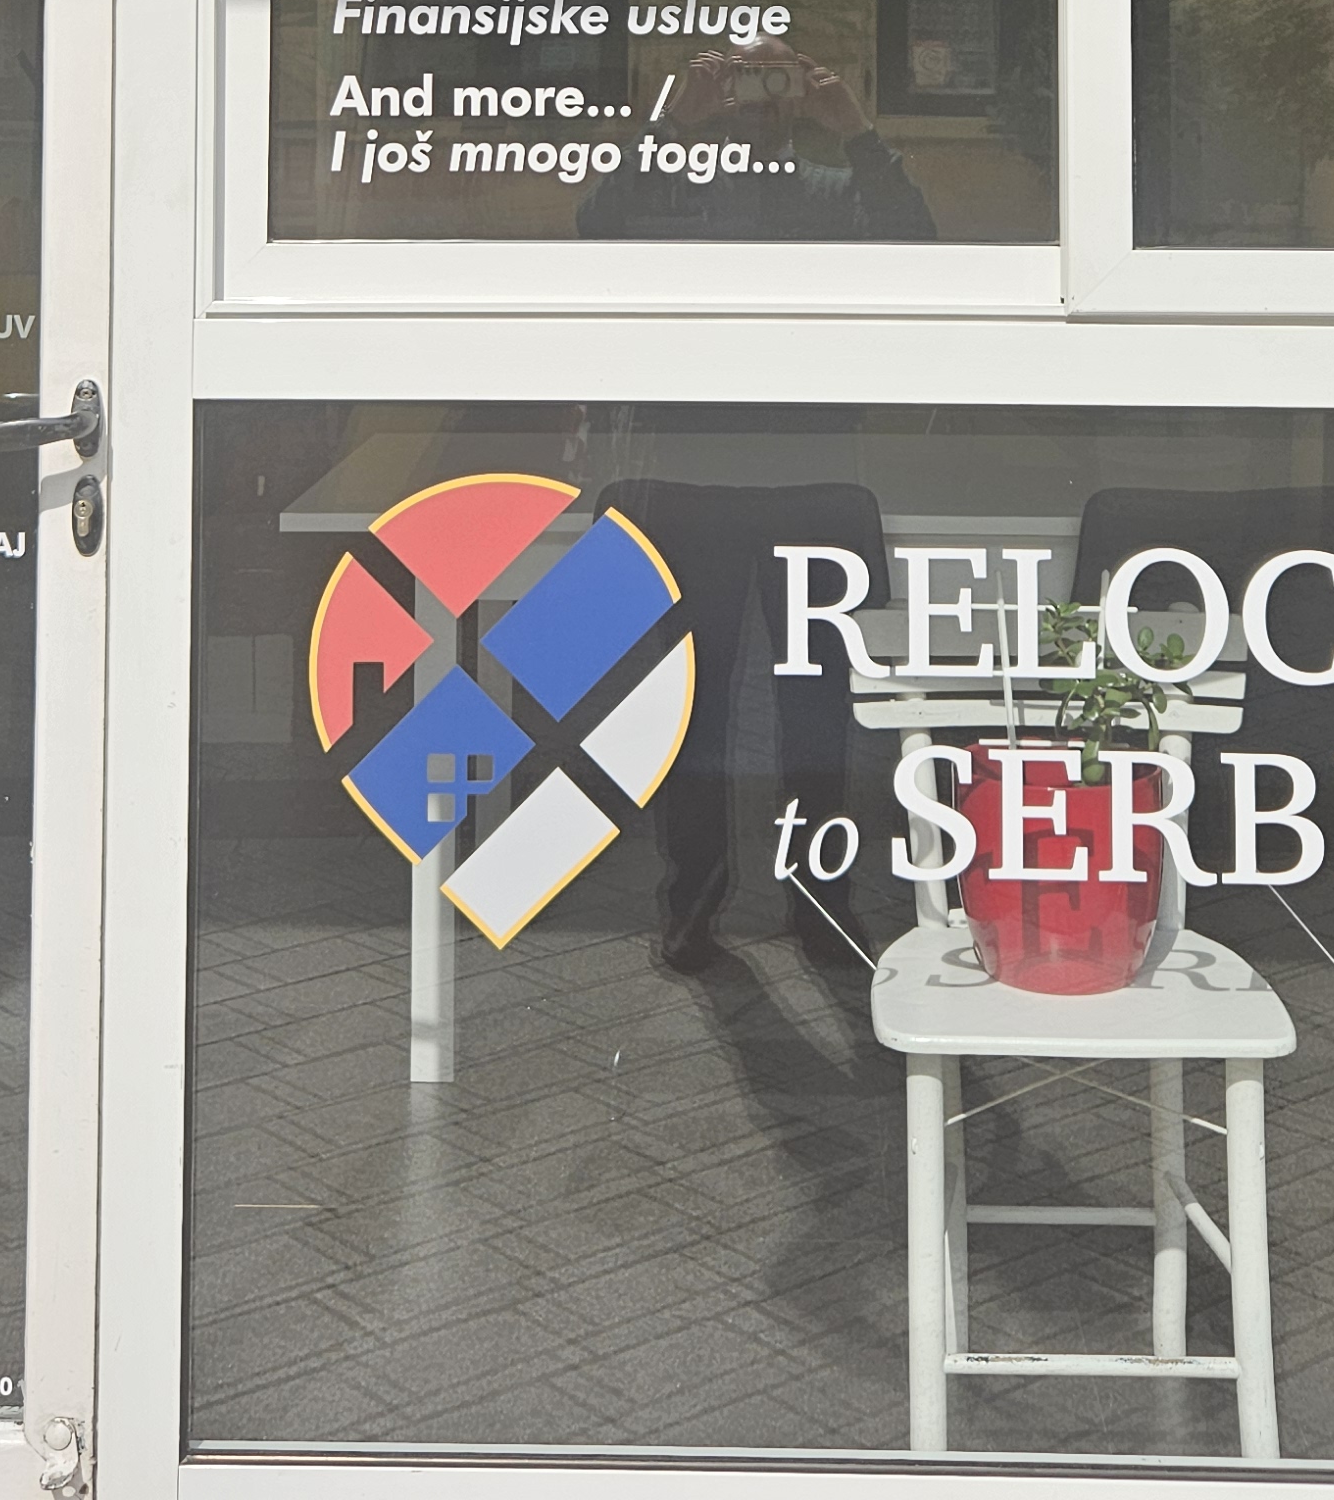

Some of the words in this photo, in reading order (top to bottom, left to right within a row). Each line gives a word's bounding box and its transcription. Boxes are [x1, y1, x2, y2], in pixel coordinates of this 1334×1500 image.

[329, 73, 433, 117] And
[453, 86, 632, 118] more...
[649, 74, 676, 122] /
[330, 130, 347, 172] I
[361, 128, 434, 184] još
[449, 142, 622, 184] mnogo
[638, 134, 796, 184] toga...
[773, 797, 860, 881] to
